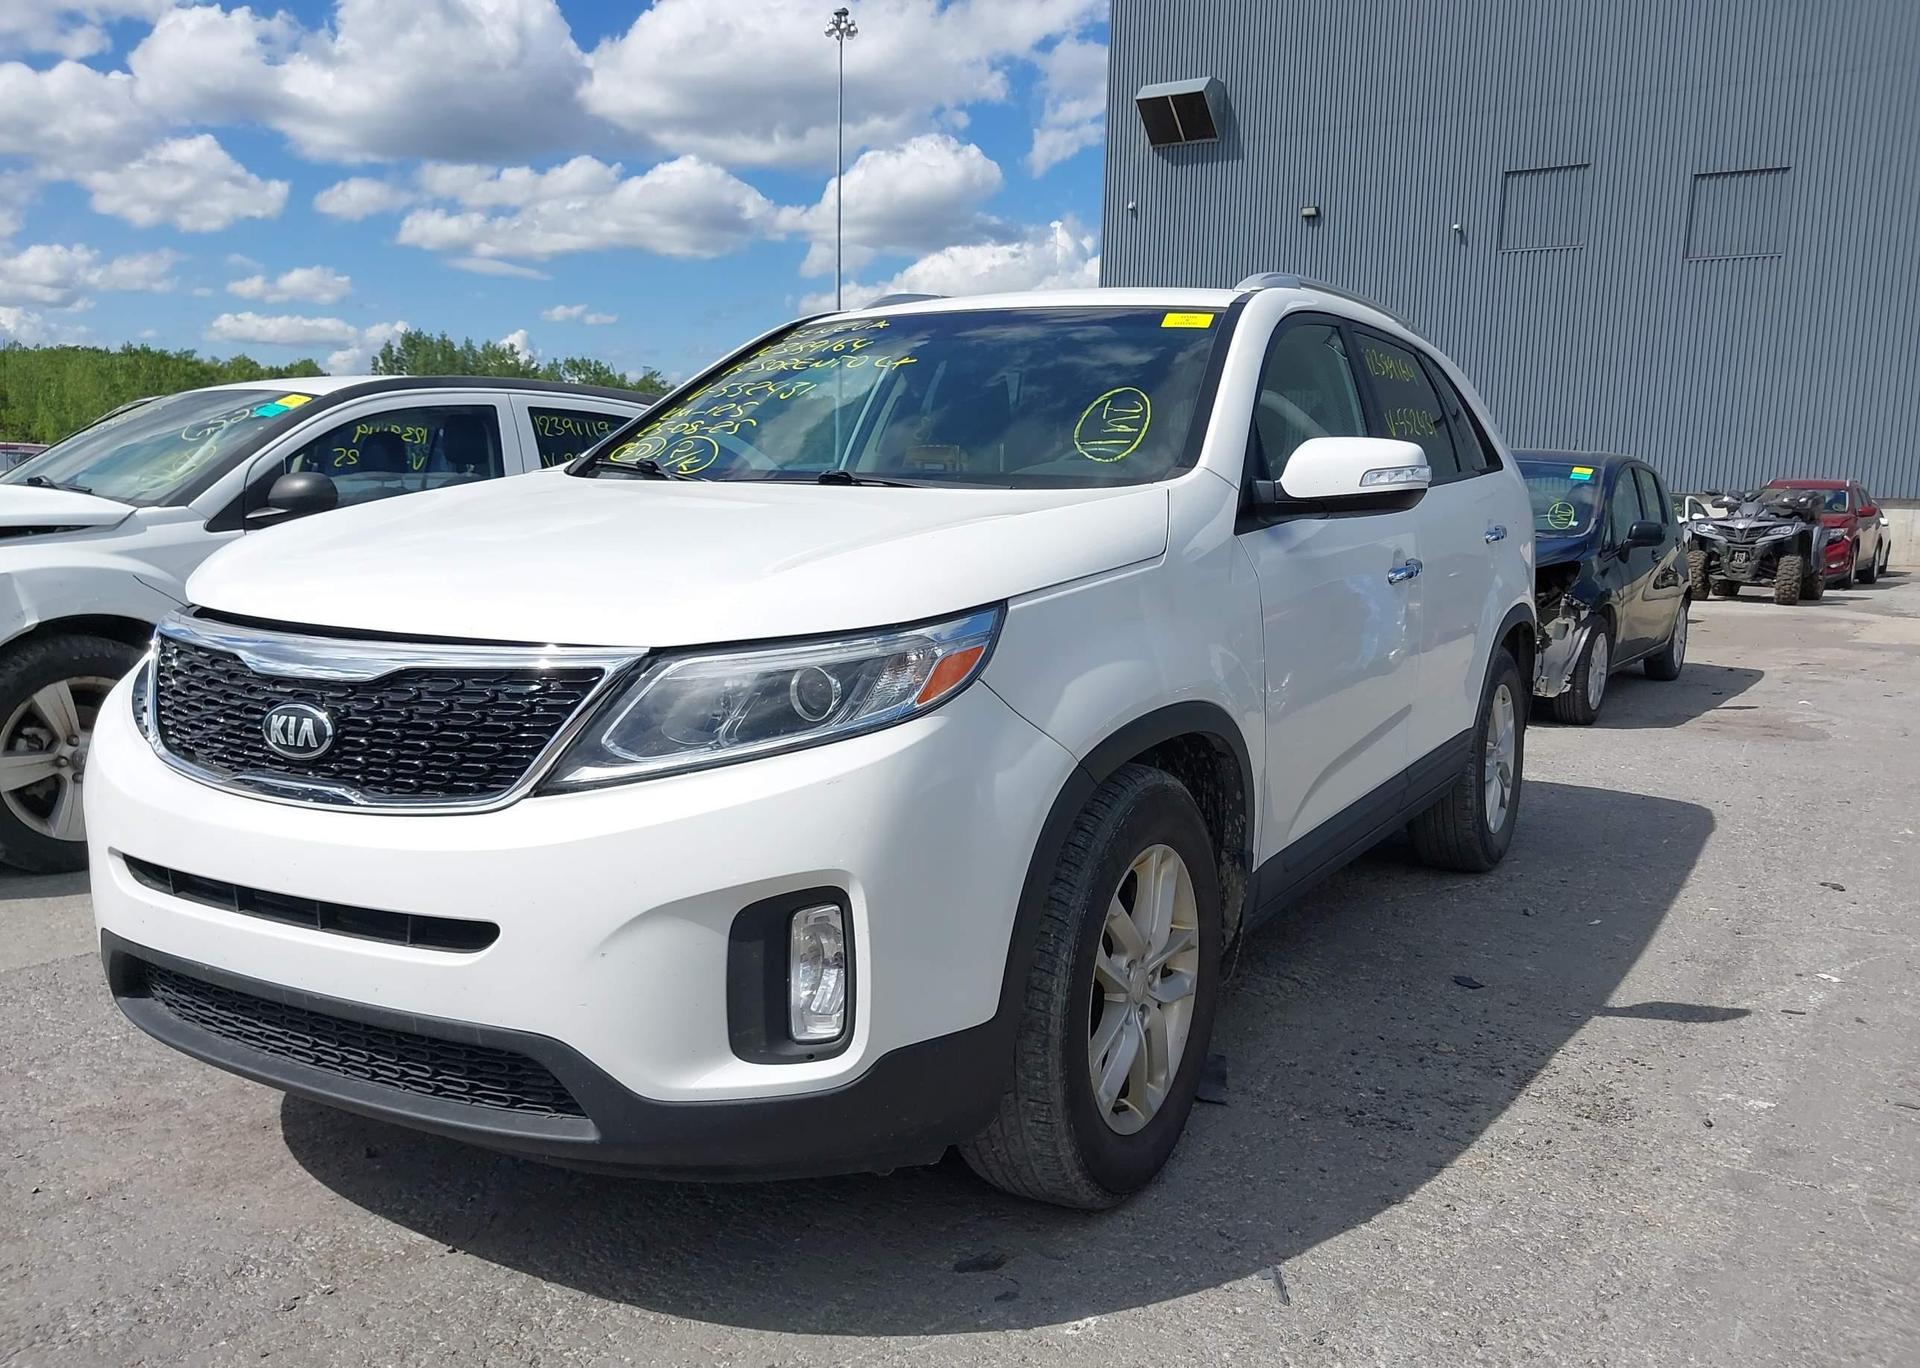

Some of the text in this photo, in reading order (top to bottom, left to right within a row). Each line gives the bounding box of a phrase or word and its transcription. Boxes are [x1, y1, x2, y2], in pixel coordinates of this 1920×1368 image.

[750, 355, 868, 373] SORENTO
[533, 415, 610, 437] 12391119
[270, 714, 319, 748] KIA
